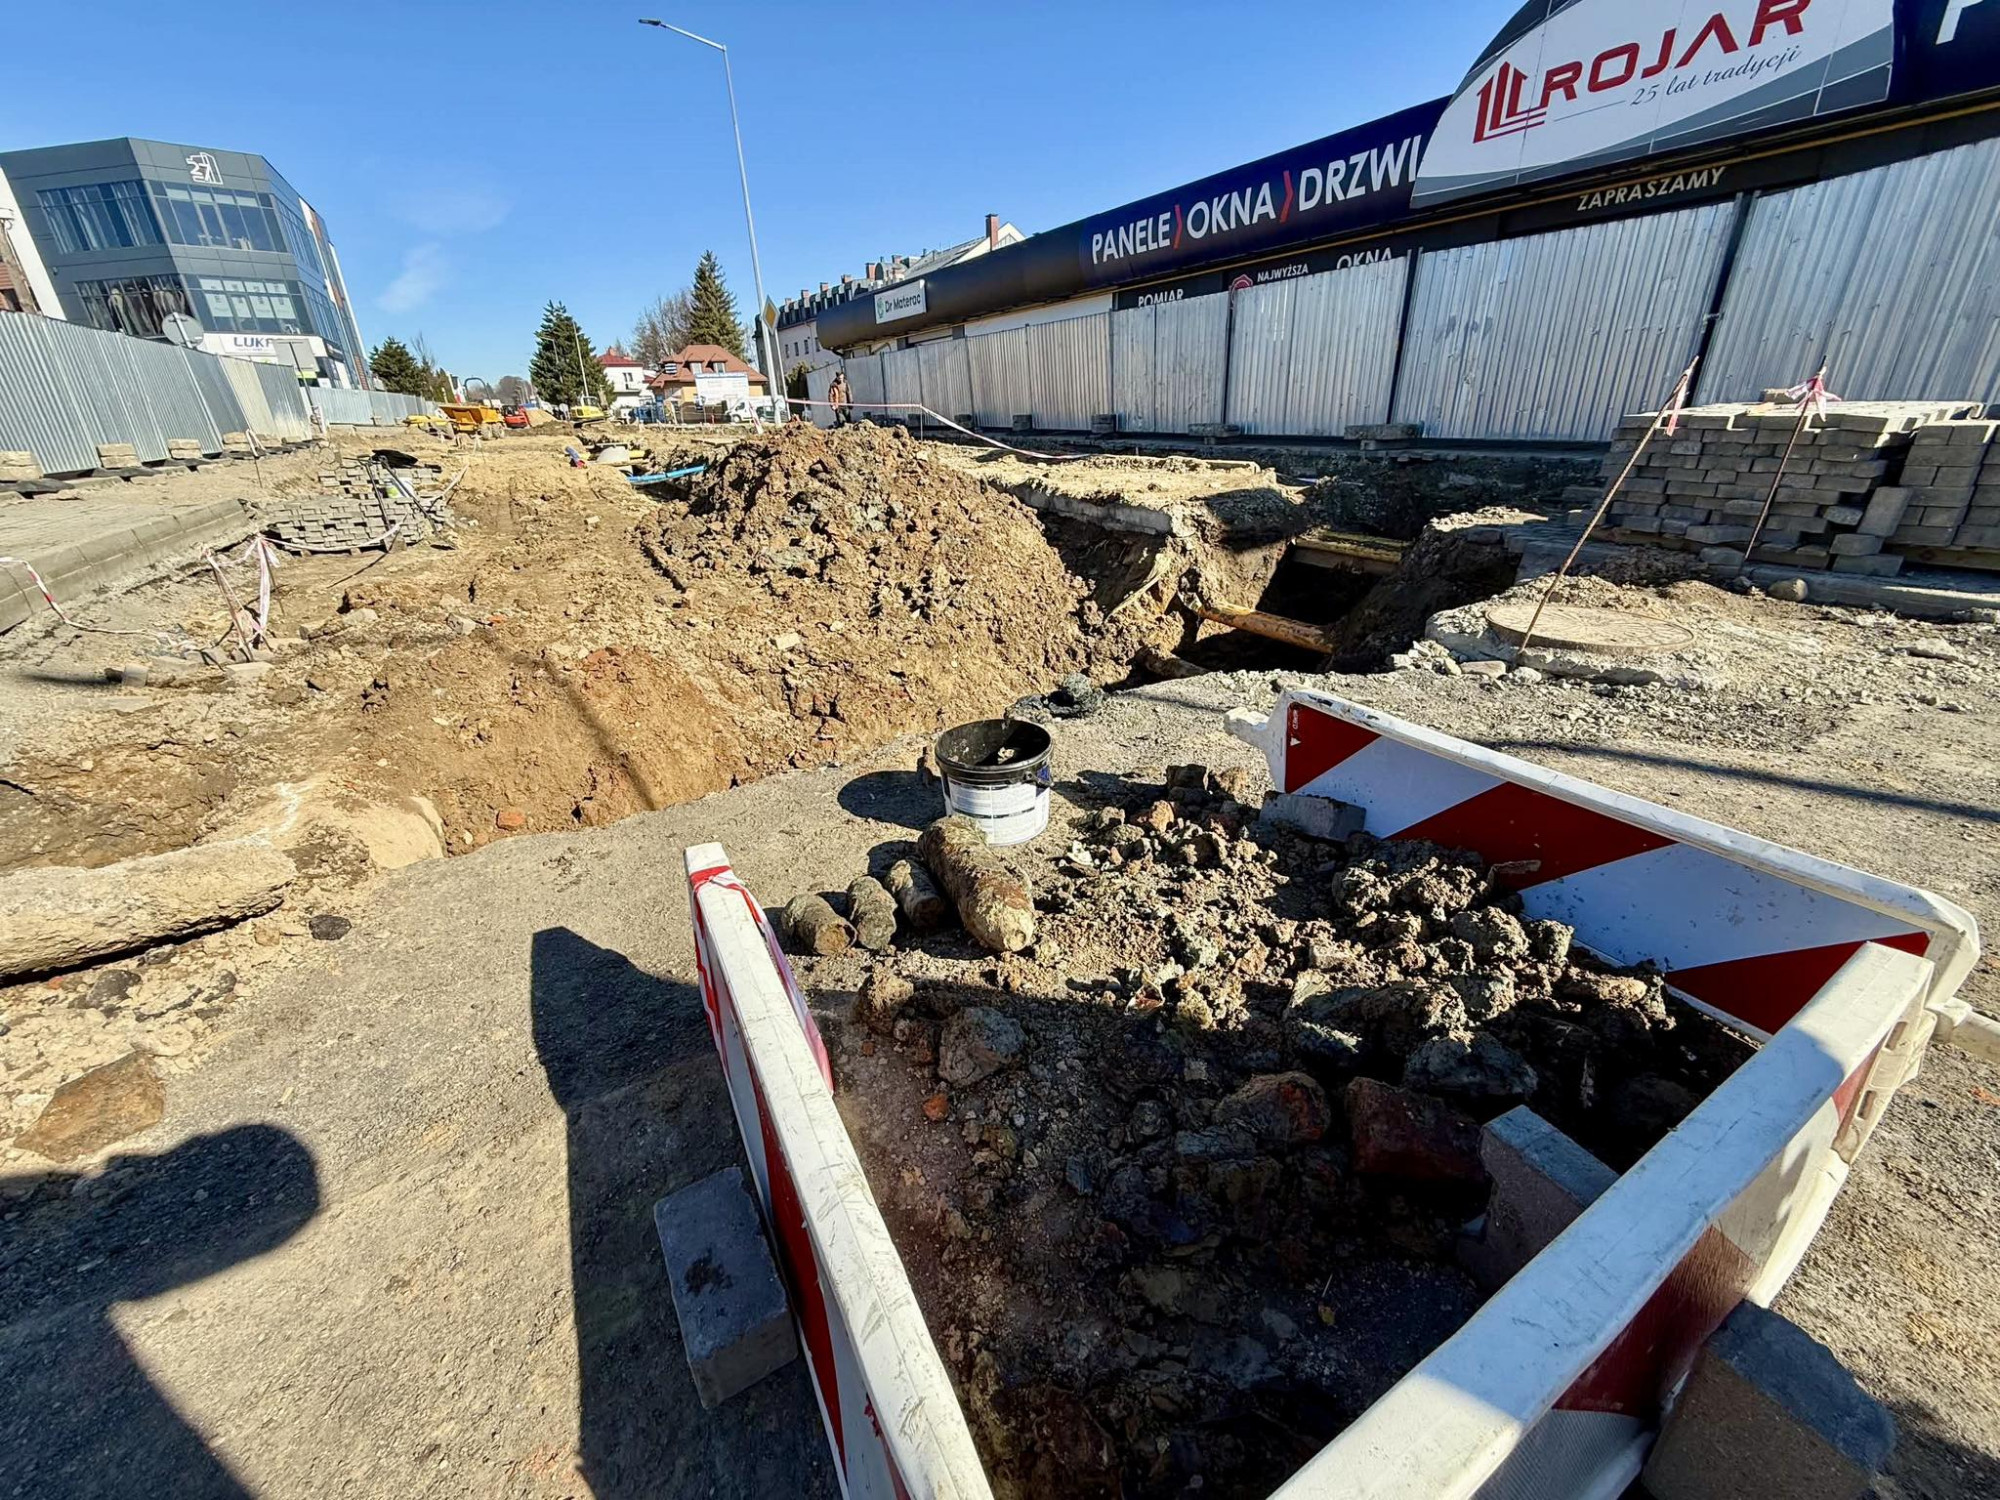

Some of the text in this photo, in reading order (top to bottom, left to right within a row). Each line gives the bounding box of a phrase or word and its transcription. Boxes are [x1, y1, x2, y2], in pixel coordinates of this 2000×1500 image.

[1543, 0, 1812, 101] ROJAR
[1630, 45, 1802, 106] 25 lat tradycji
[1091, 134, 1422, 264] PANELE OKNA DRZWI
[1577, 166, 1726, 211] ZAPRASZAMY
[1138, 288, 1184, 307] POMIAR
[1257, 264, 1309, 283] NAJWYŻSZA
